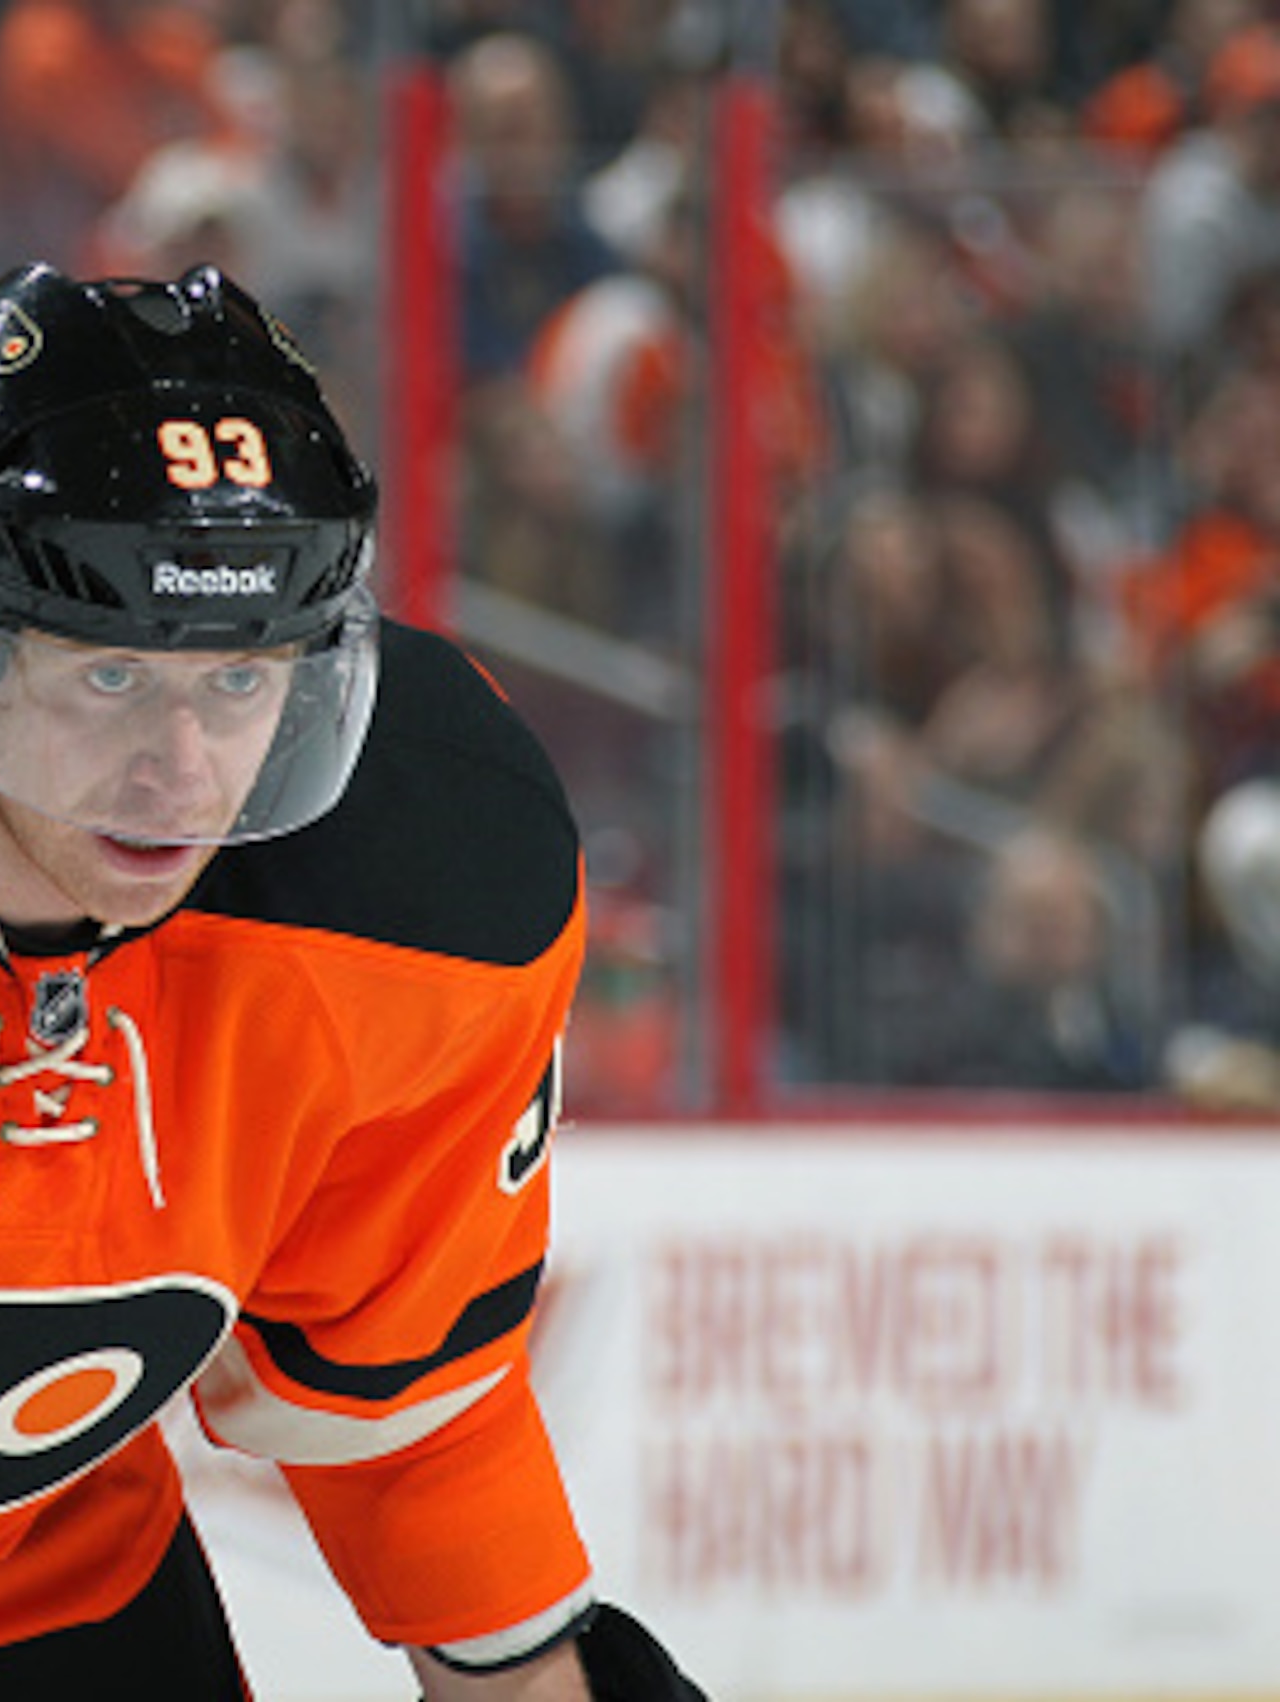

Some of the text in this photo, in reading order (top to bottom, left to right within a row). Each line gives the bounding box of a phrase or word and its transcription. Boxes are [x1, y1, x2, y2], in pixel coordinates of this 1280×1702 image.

[158, 416, 272, 490] 93
[152, 563, 277, 594] Reebok
[640, 1230, 1190, 1408] BREWED THE
[638, 1428, 1092, 1598] HARD WAY
